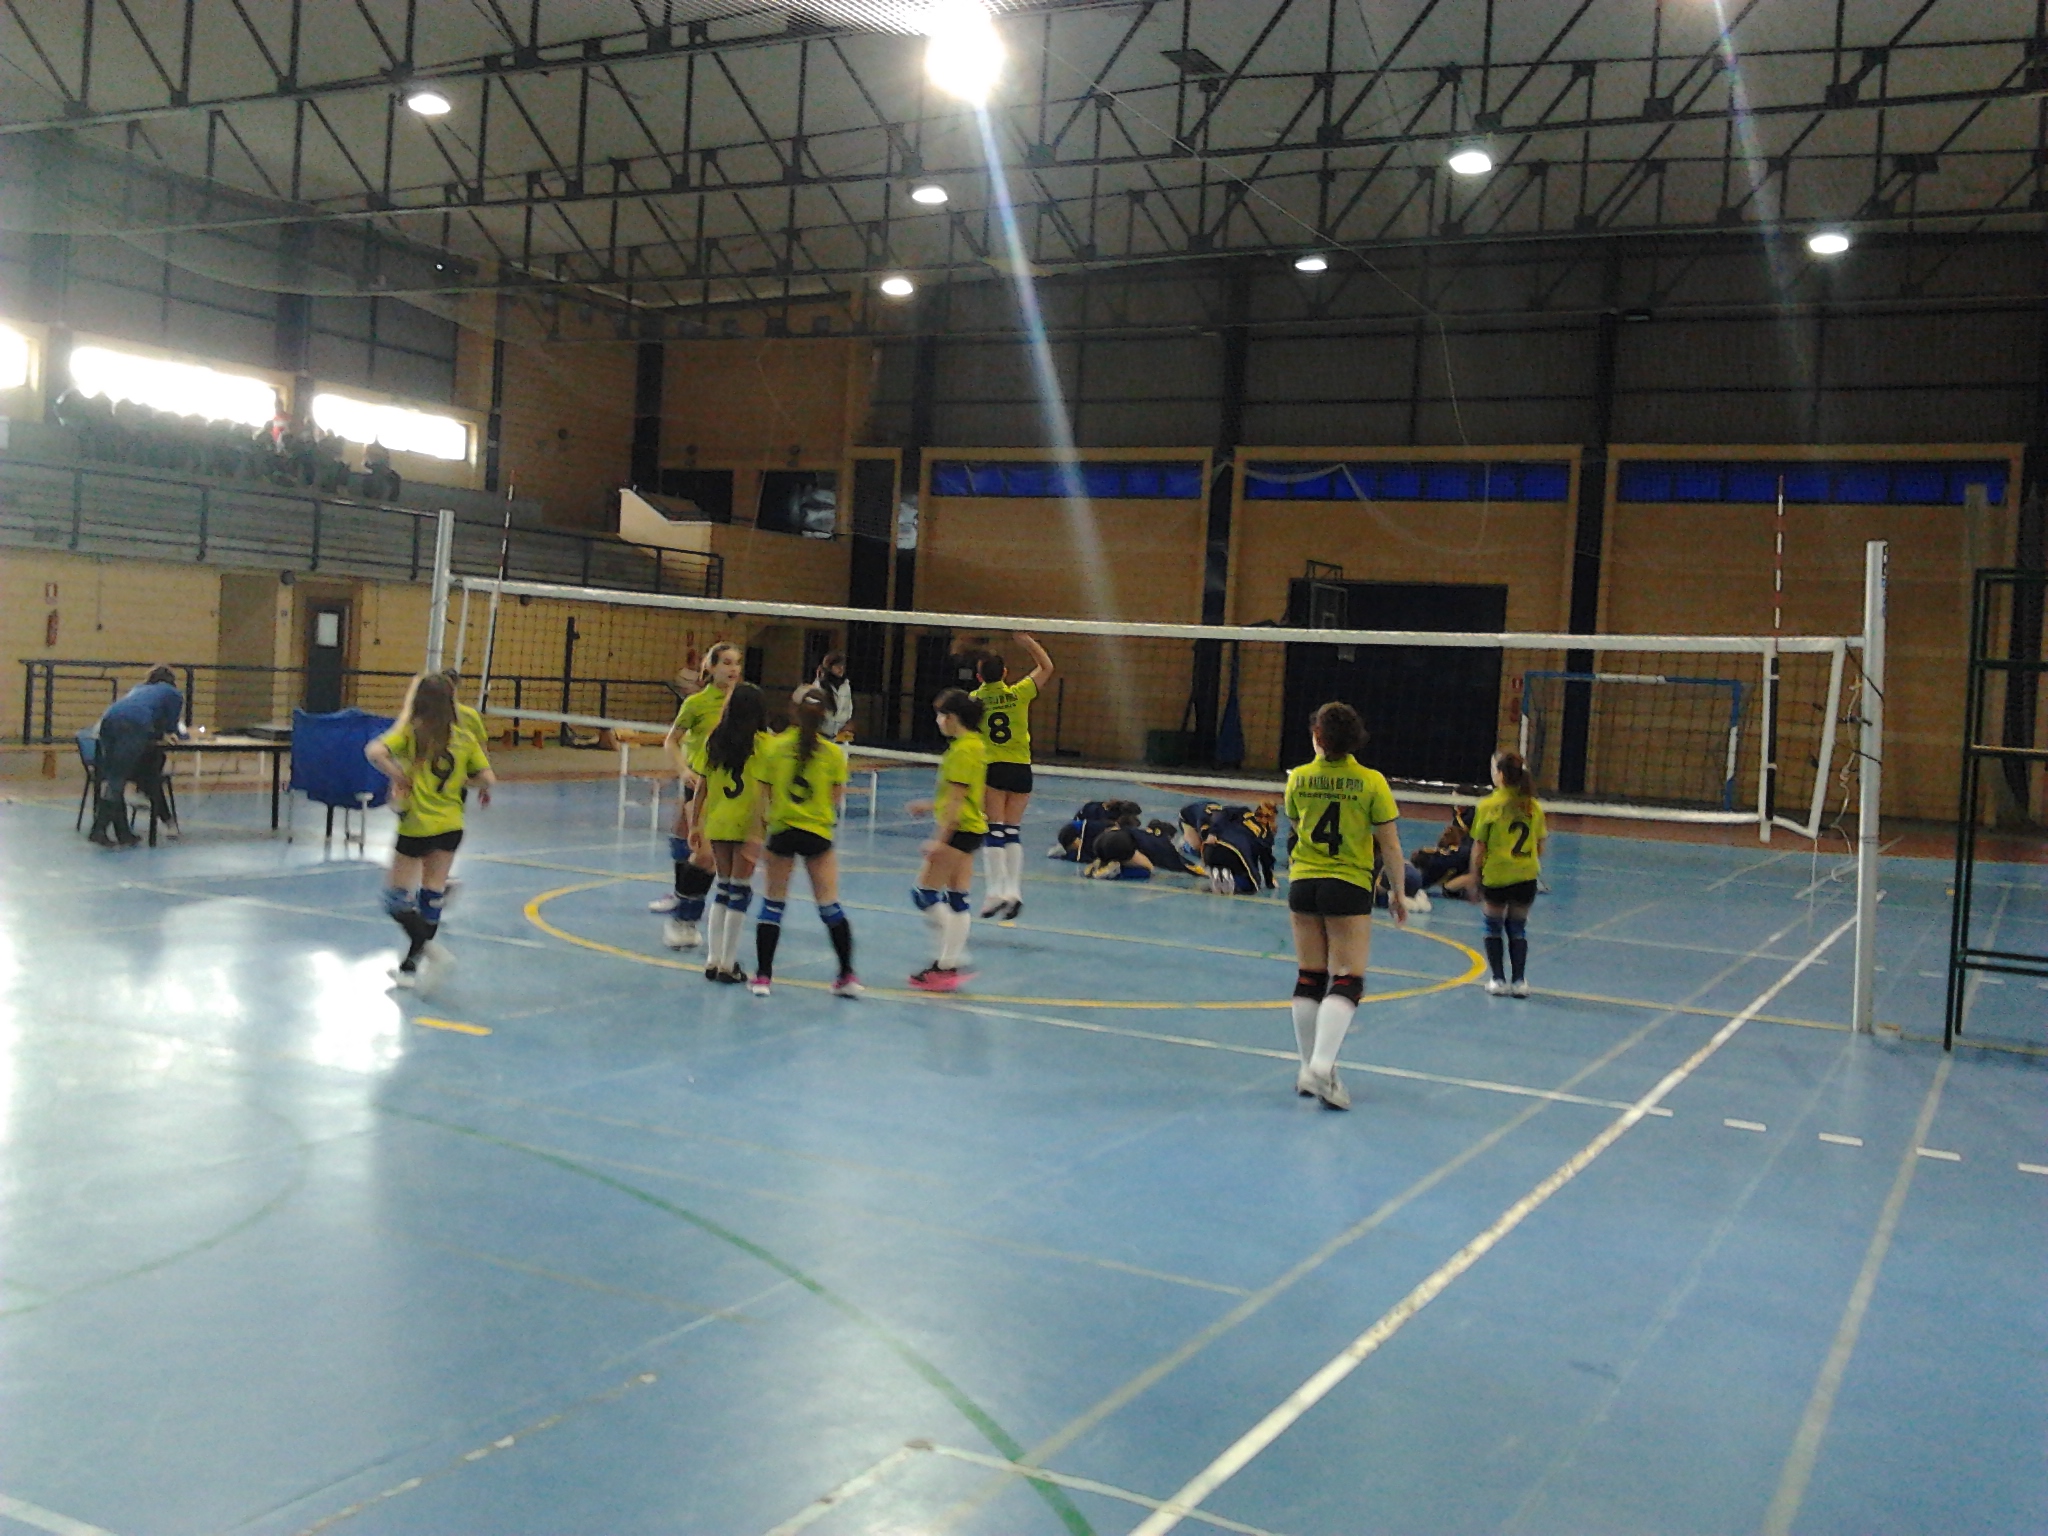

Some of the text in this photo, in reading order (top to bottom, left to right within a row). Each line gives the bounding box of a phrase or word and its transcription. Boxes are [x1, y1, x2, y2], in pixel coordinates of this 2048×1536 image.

[988, 711, 1012, 744] 8
[431, 749, 455, 793] 9
[1311, 801, 1343, 857] 4
[1508, 821, 1532, 858] 2
